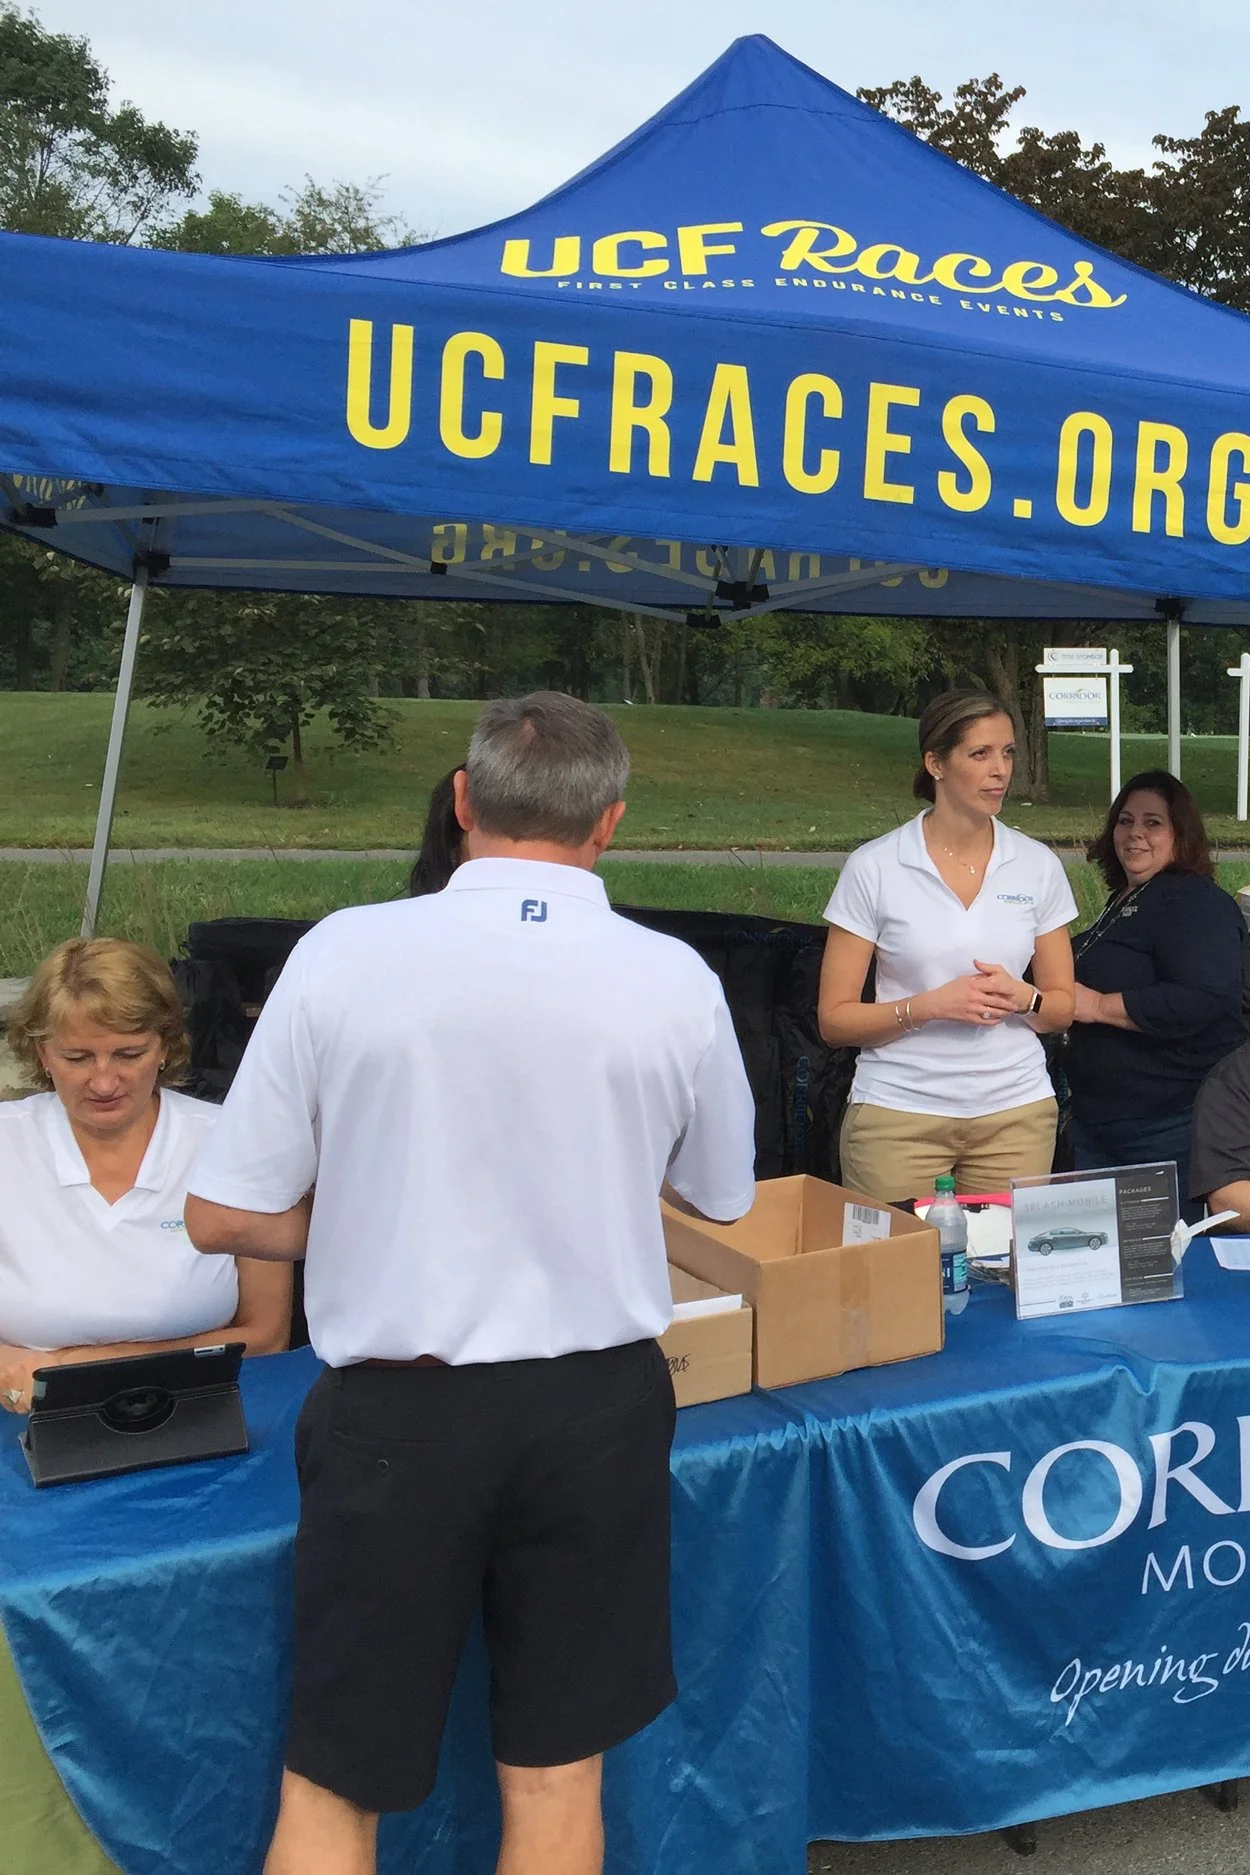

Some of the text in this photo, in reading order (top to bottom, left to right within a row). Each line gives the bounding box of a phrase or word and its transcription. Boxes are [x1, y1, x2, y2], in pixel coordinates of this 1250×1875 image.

[500, 219, 1128, 308] UCF Races
[557, 277, 1065, 323] FIRST CLASS ENDURANCE EVENTS
[521, 899, 547, 922] FJ
[1050, 1645, 1219, 1727] Opening
